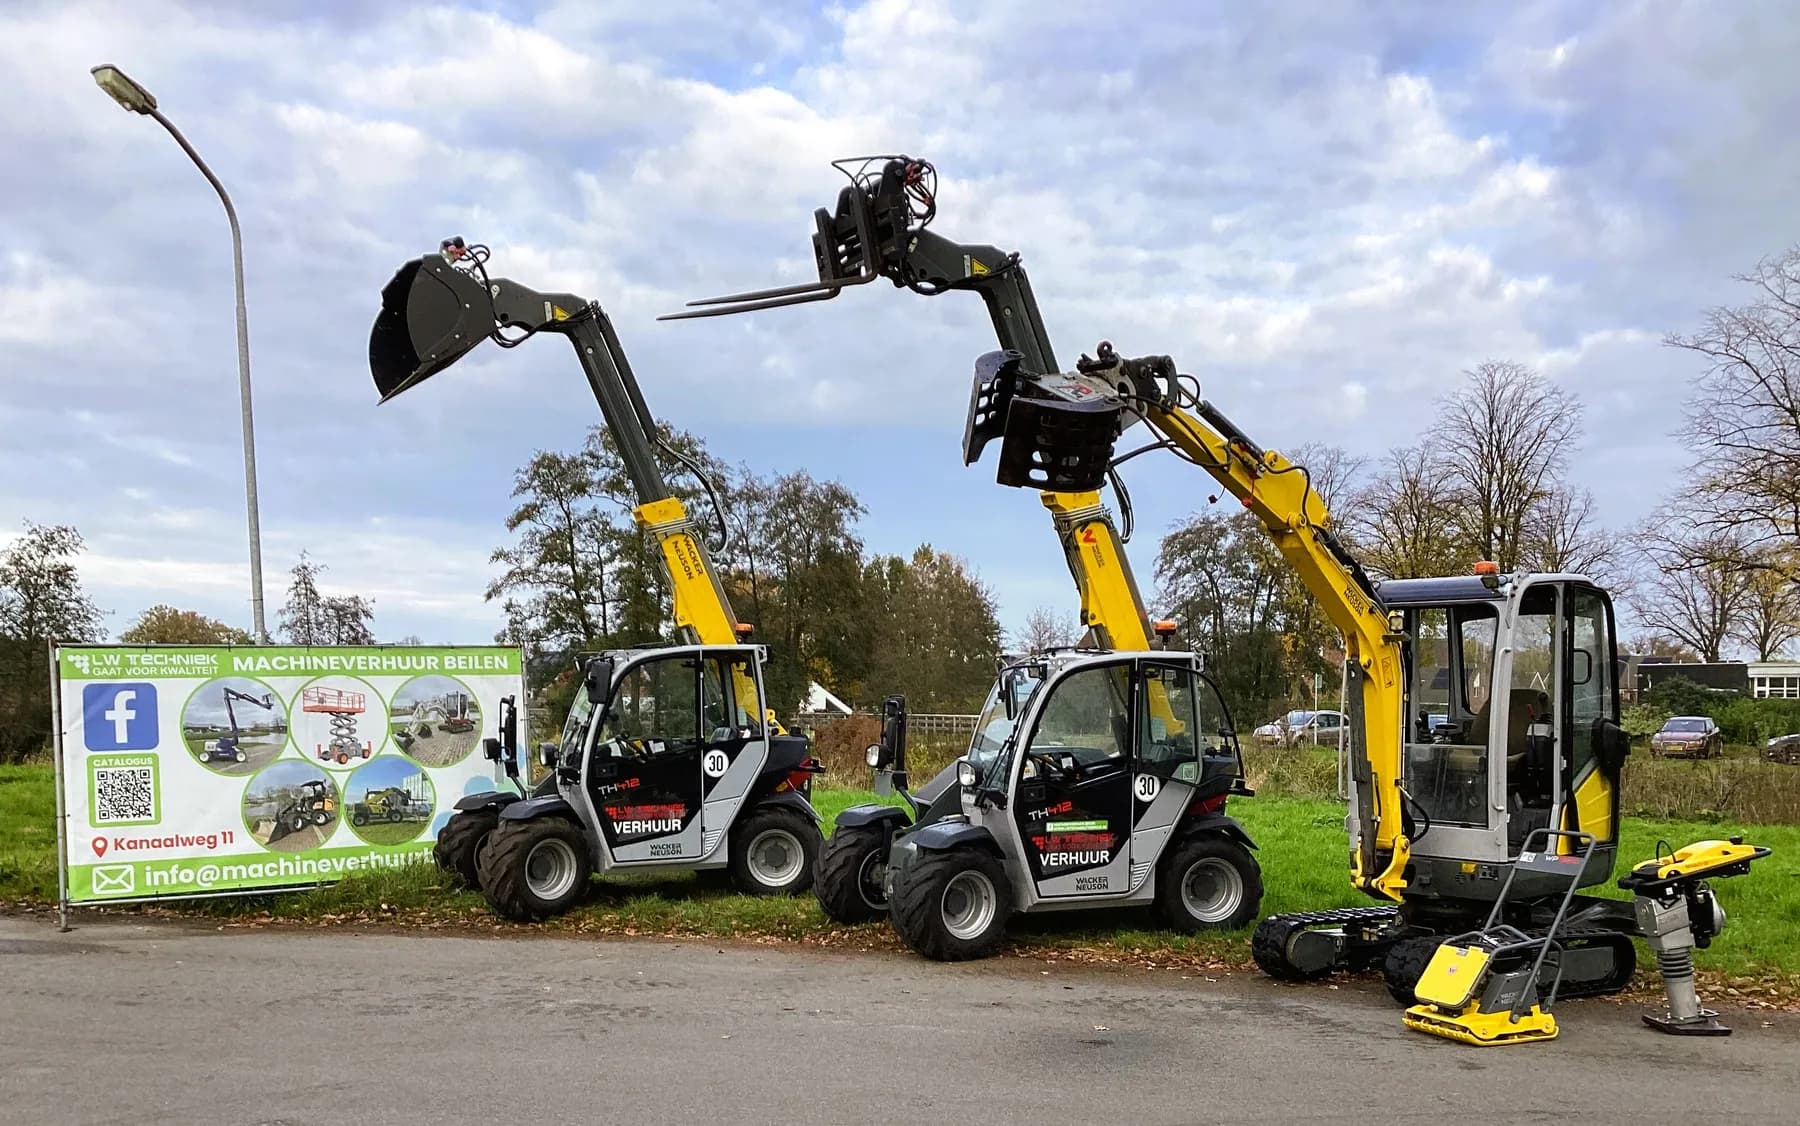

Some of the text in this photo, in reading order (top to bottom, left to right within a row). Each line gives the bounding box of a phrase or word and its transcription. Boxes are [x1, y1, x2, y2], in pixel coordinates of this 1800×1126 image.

[1083, 528, 1097, 543] 2
[672, 541, 695, 580] NEUSON
[683, 534, 704, 577] WACKER
[92, 654, 121, 666] LW
[232, 655, 509, 672] MACHINEVERHUUR BEILEN
[92, 666, 218, 676] GAAT VOOR KWALITEIT
[93, 757, 153, 767] CATALOGUS
[708, 755, 724, 772] 30
[1139, 776, 1155, 796] 30
[613, 818, 682, 835] VERHUUR
[114, 831, 234, 851] Kanaalweg 11
[650, 849, 682, 857] NEUSON
[1040, 850, 1110, 867] VERHUUR
[1076, 876, 1108, 884] WACKER
[1076, 883, 1109, 891] NEUSON
